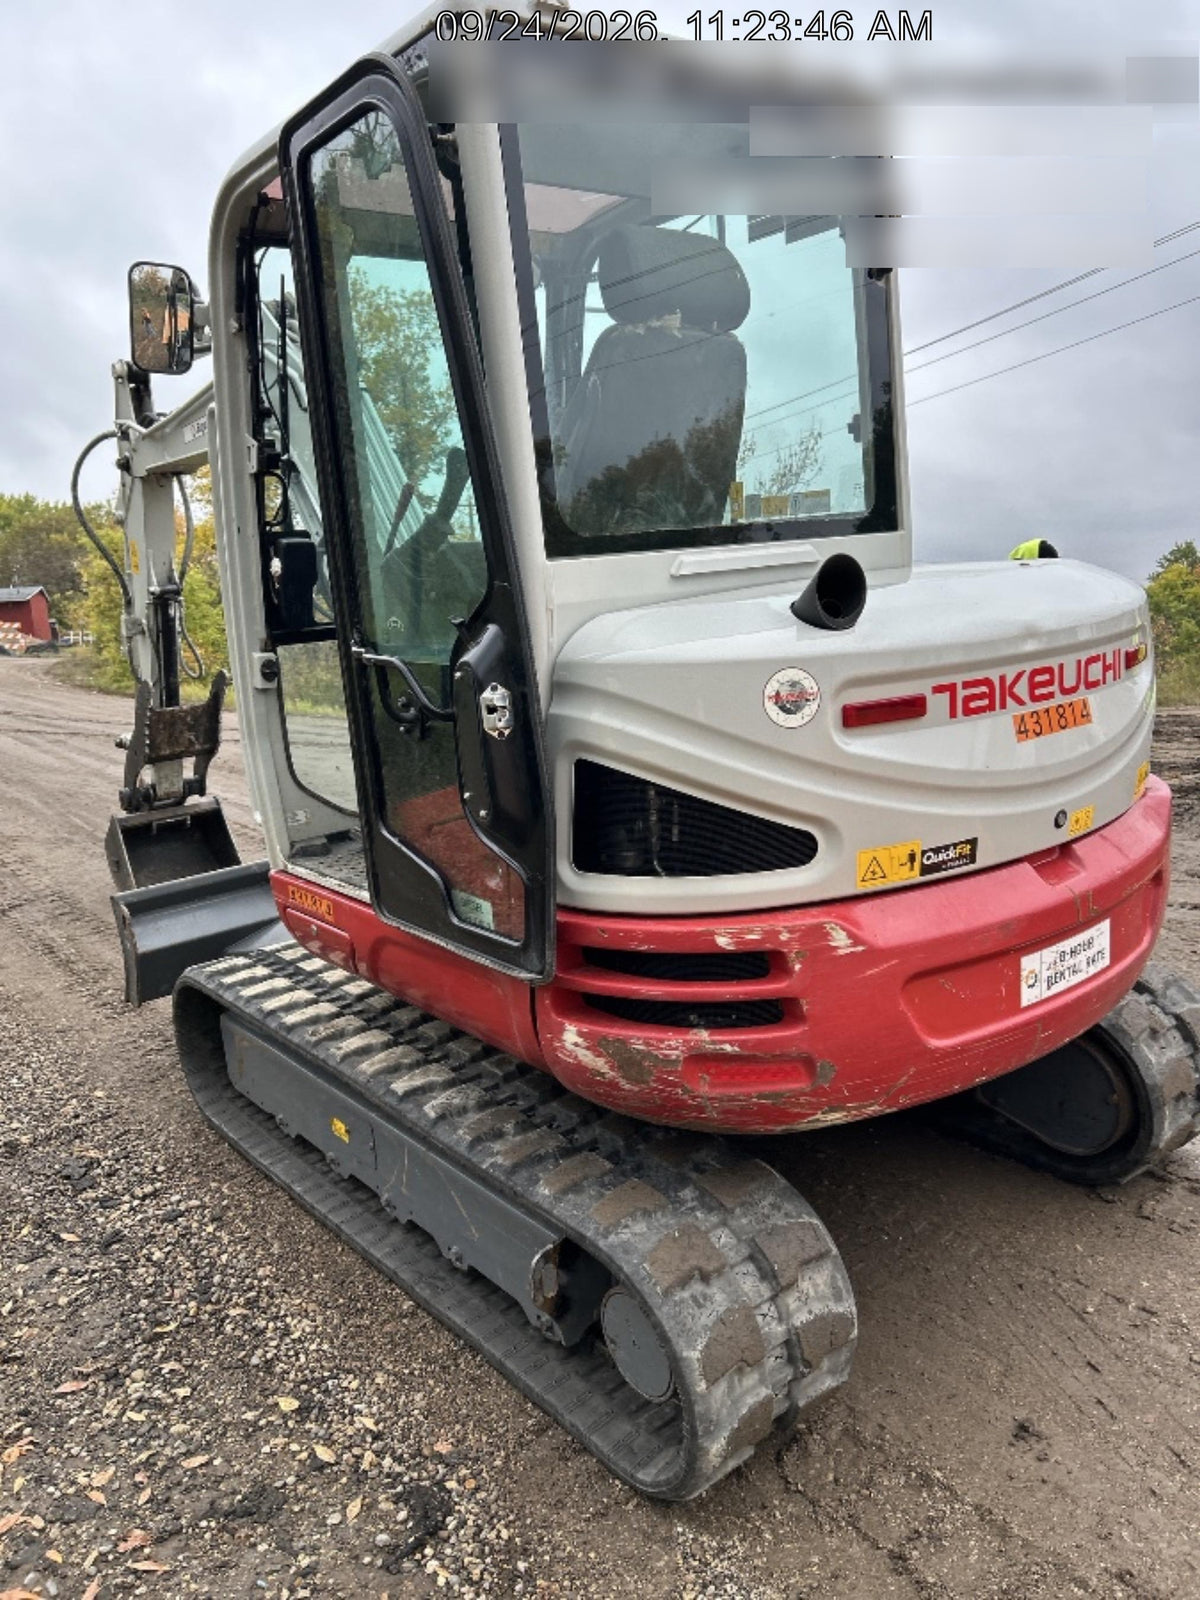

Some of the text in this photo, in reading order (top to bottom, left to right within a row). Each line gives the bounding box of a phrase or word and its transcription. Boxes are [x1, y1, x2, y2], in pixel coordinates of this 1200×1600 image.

[931, 648, 1121, 719] TAKEUCHI
[1016, 698, 1091, 740] 431814
[922, 843, 971, 865] QuickFit
